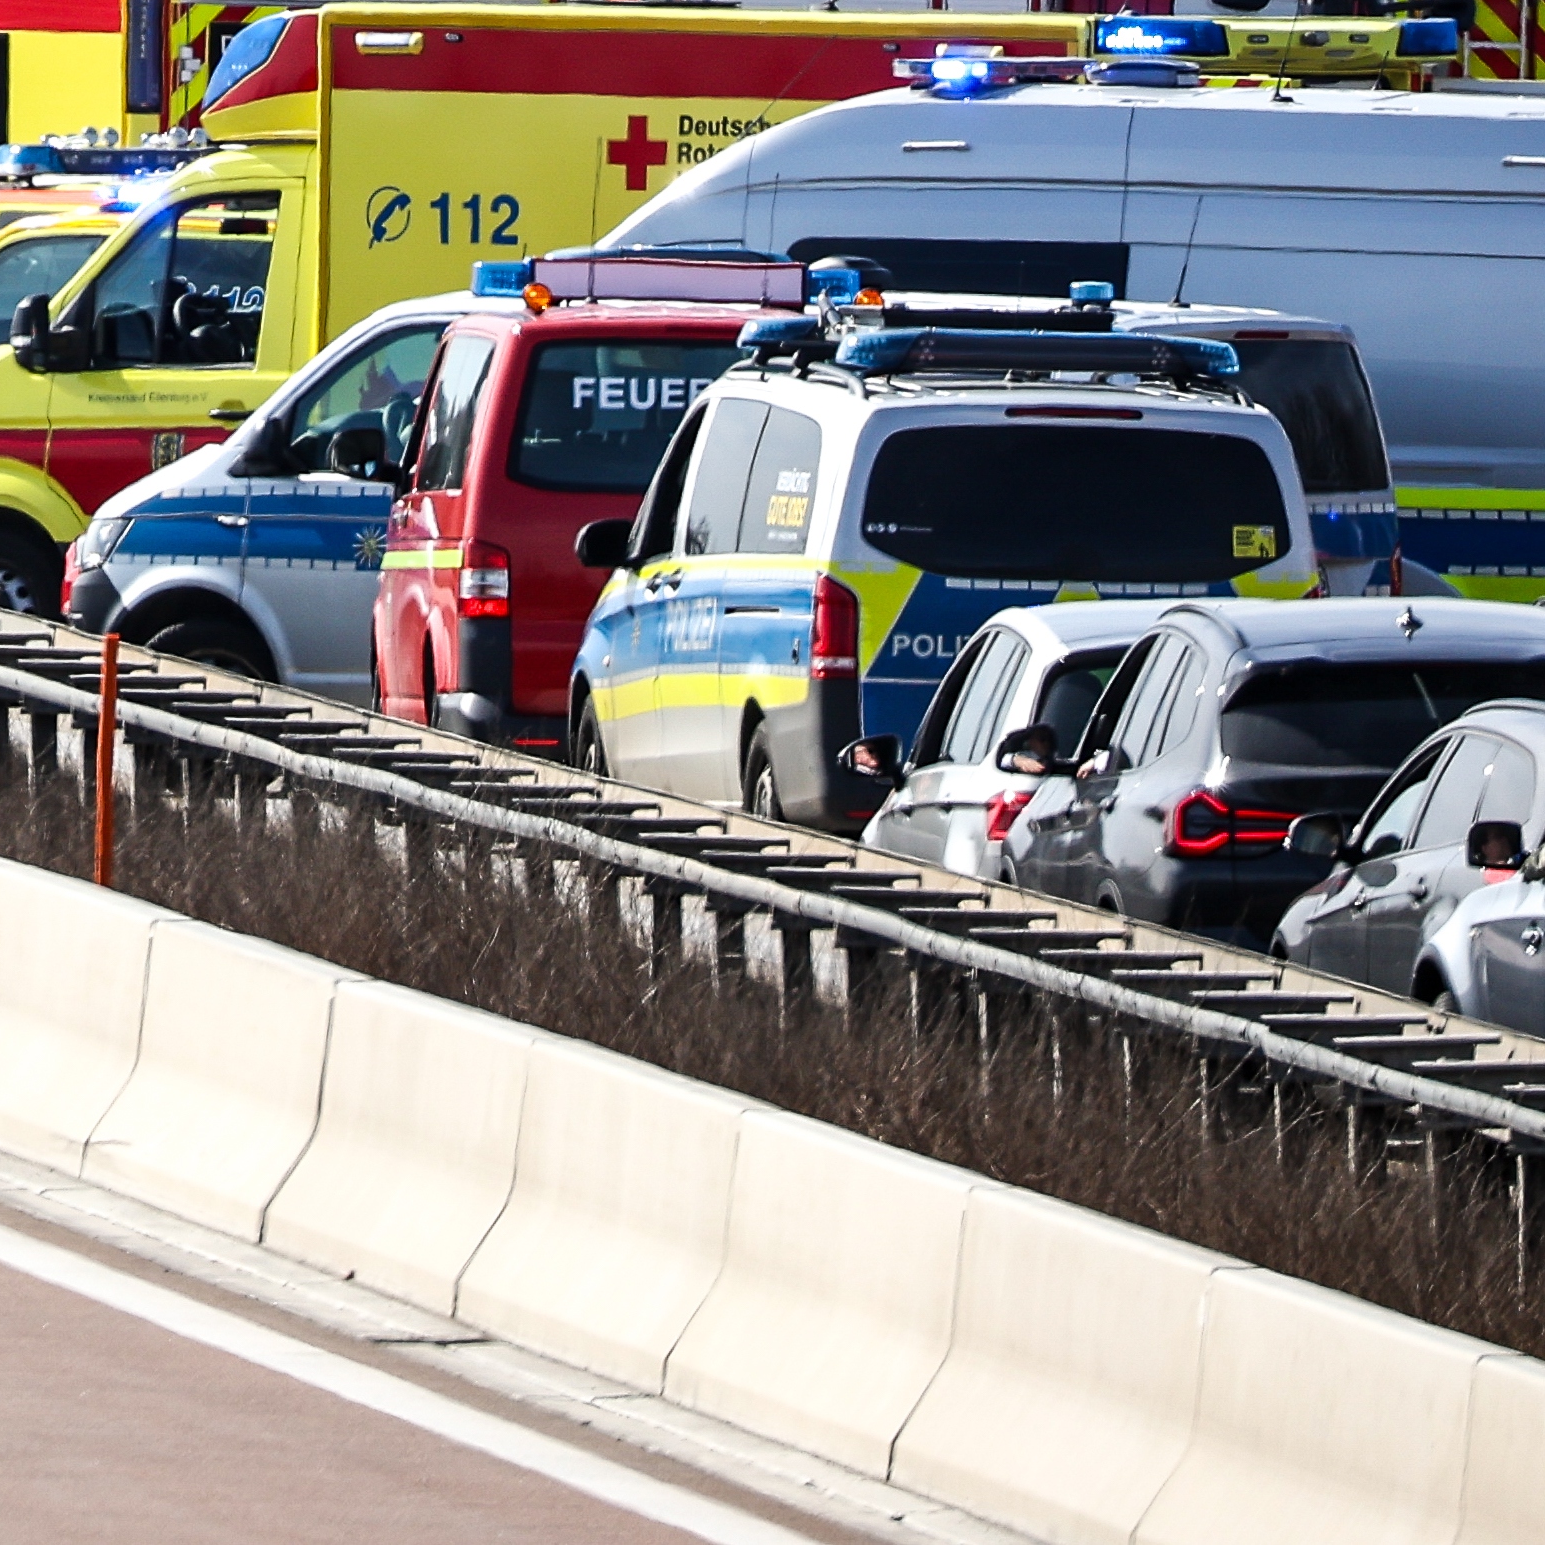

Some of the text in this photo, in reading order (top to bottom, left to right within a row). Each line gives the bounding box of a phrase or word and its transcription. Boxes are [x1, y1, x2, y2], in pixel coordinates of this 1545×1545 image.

[678, 114, 782, 137] Deutsch
[430, 192, 521, 246] 112
[891, 634, 972, 659] POLI
